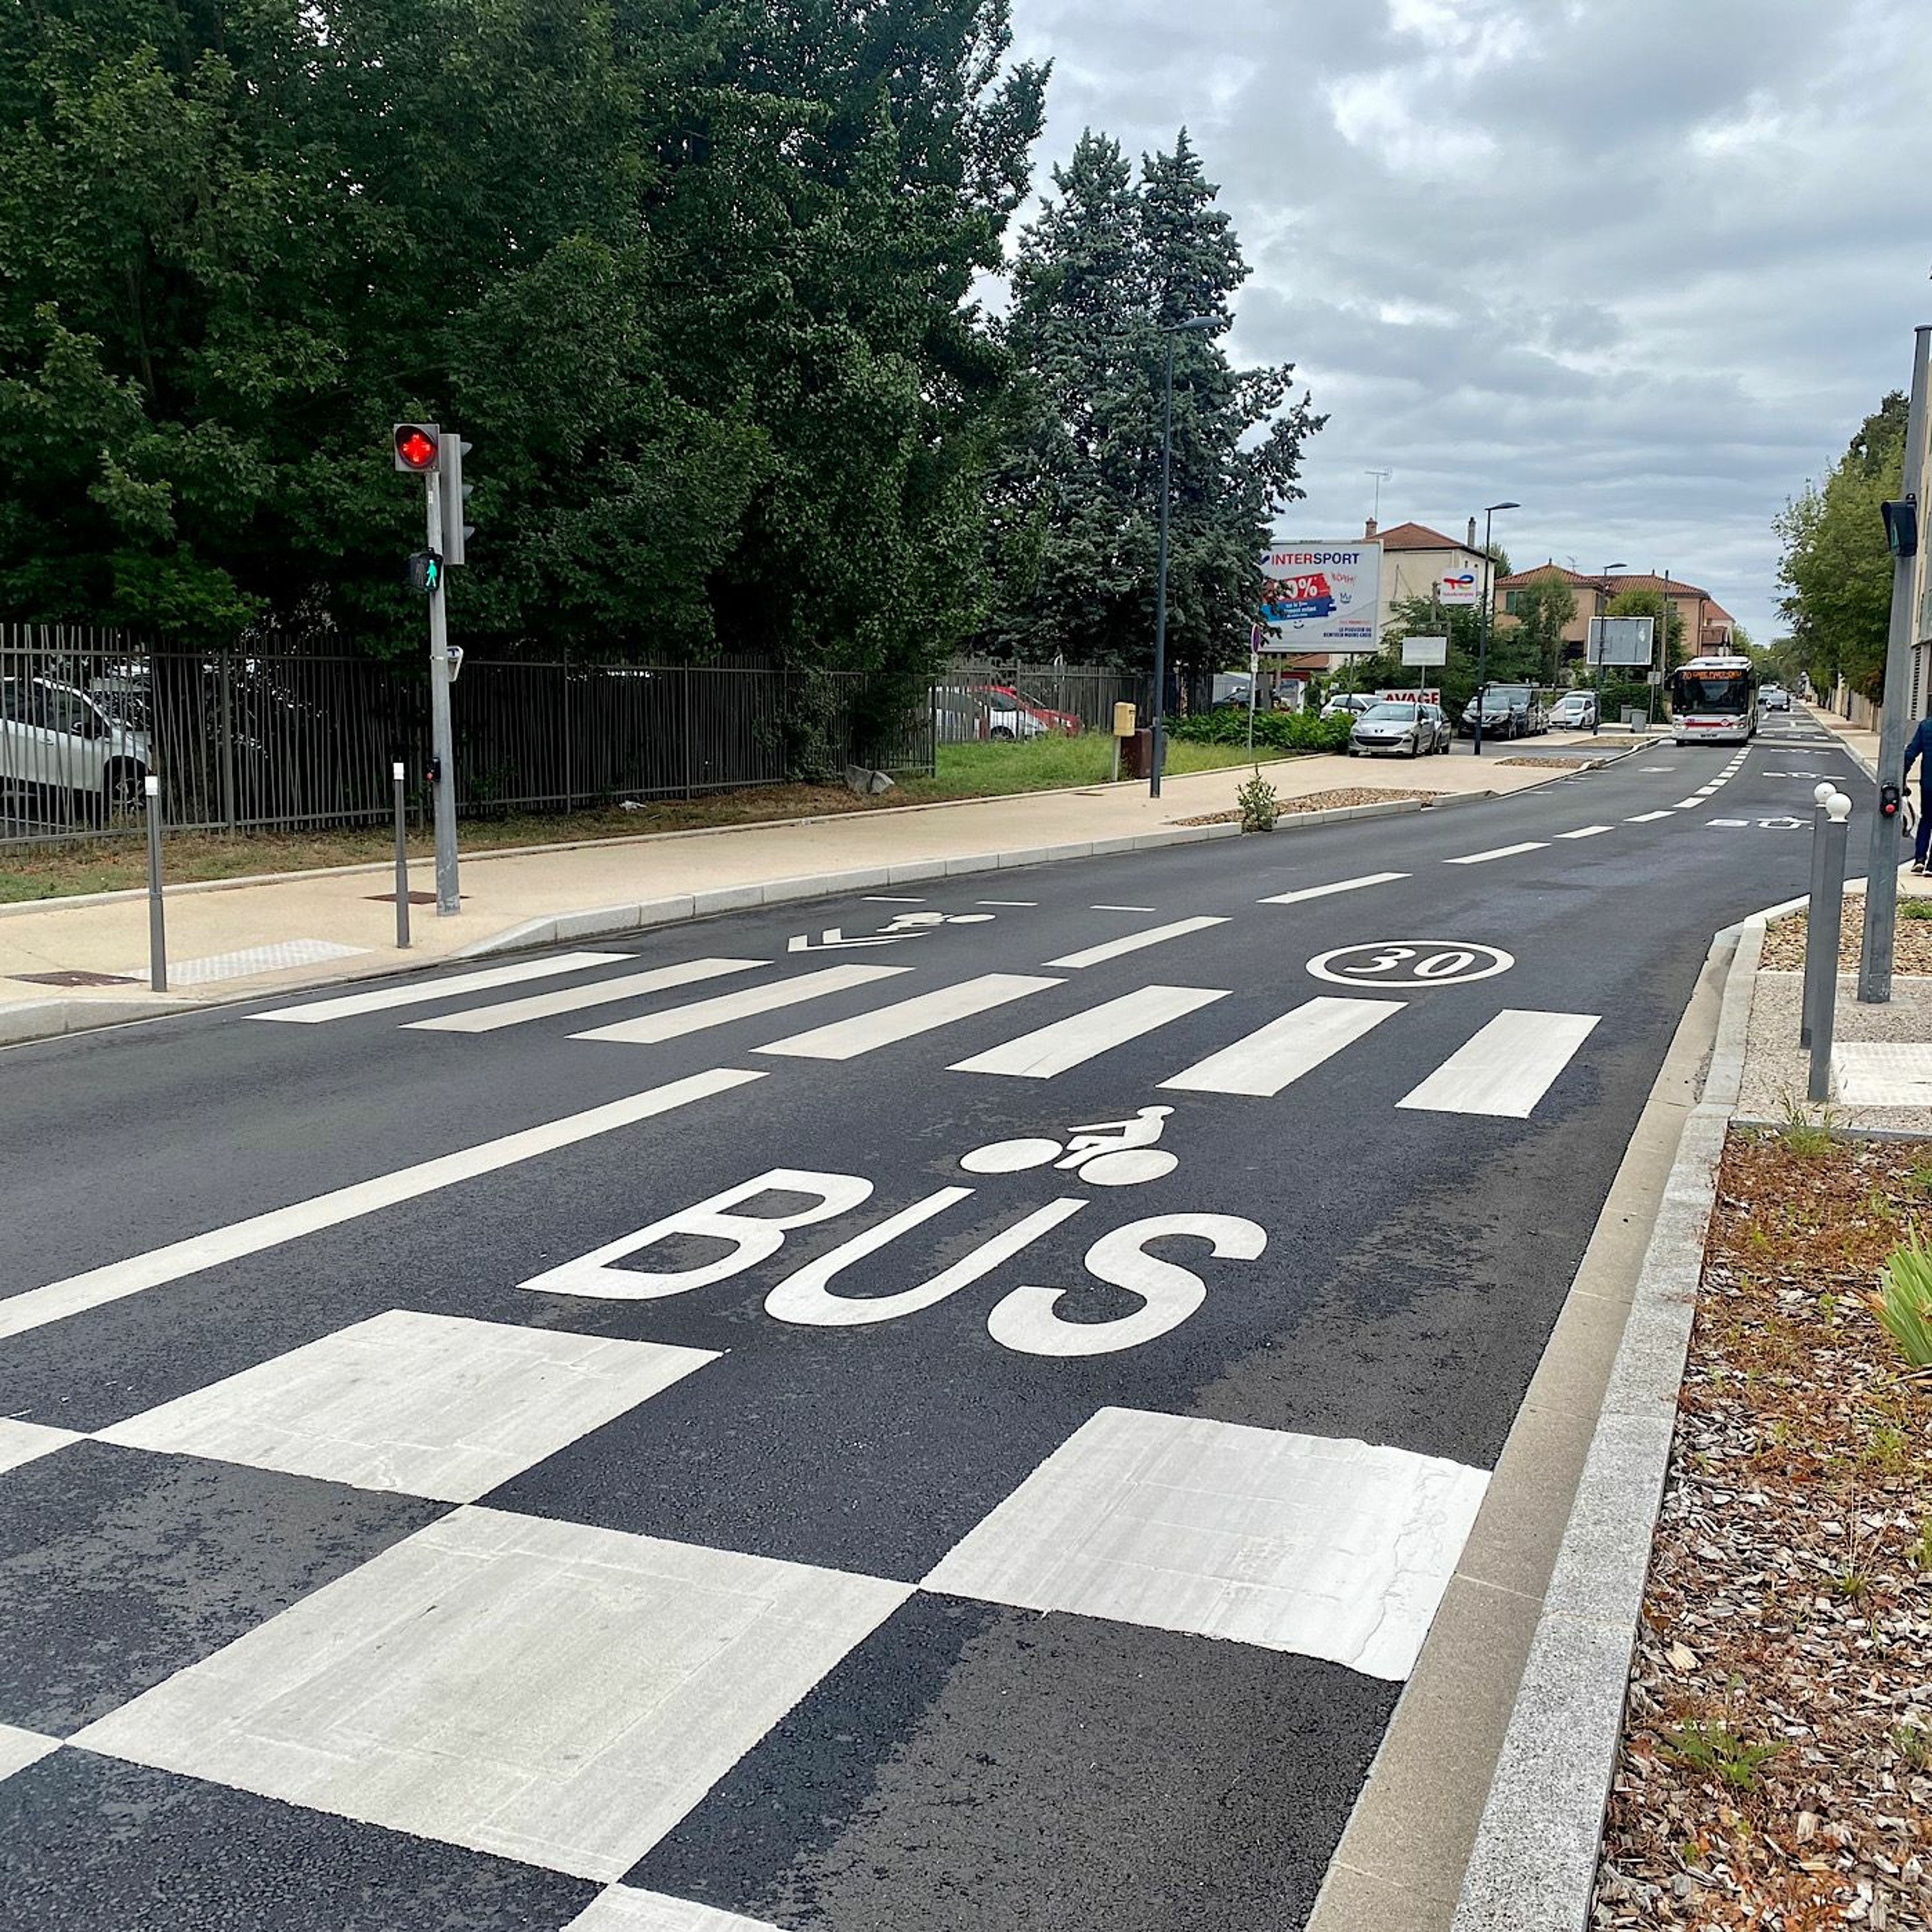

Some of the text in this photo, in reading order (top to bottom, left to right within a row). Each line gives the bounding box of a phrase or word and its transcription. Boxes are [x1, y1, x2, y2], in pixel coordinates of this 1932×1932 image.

[1271, 553, 1360, 565] INTERSPORT
[1382, 692, 1439, 705] AVAGE
[1343, 947, 1475, 977] 30
[515, 1168, 1267, 1356] BUS
